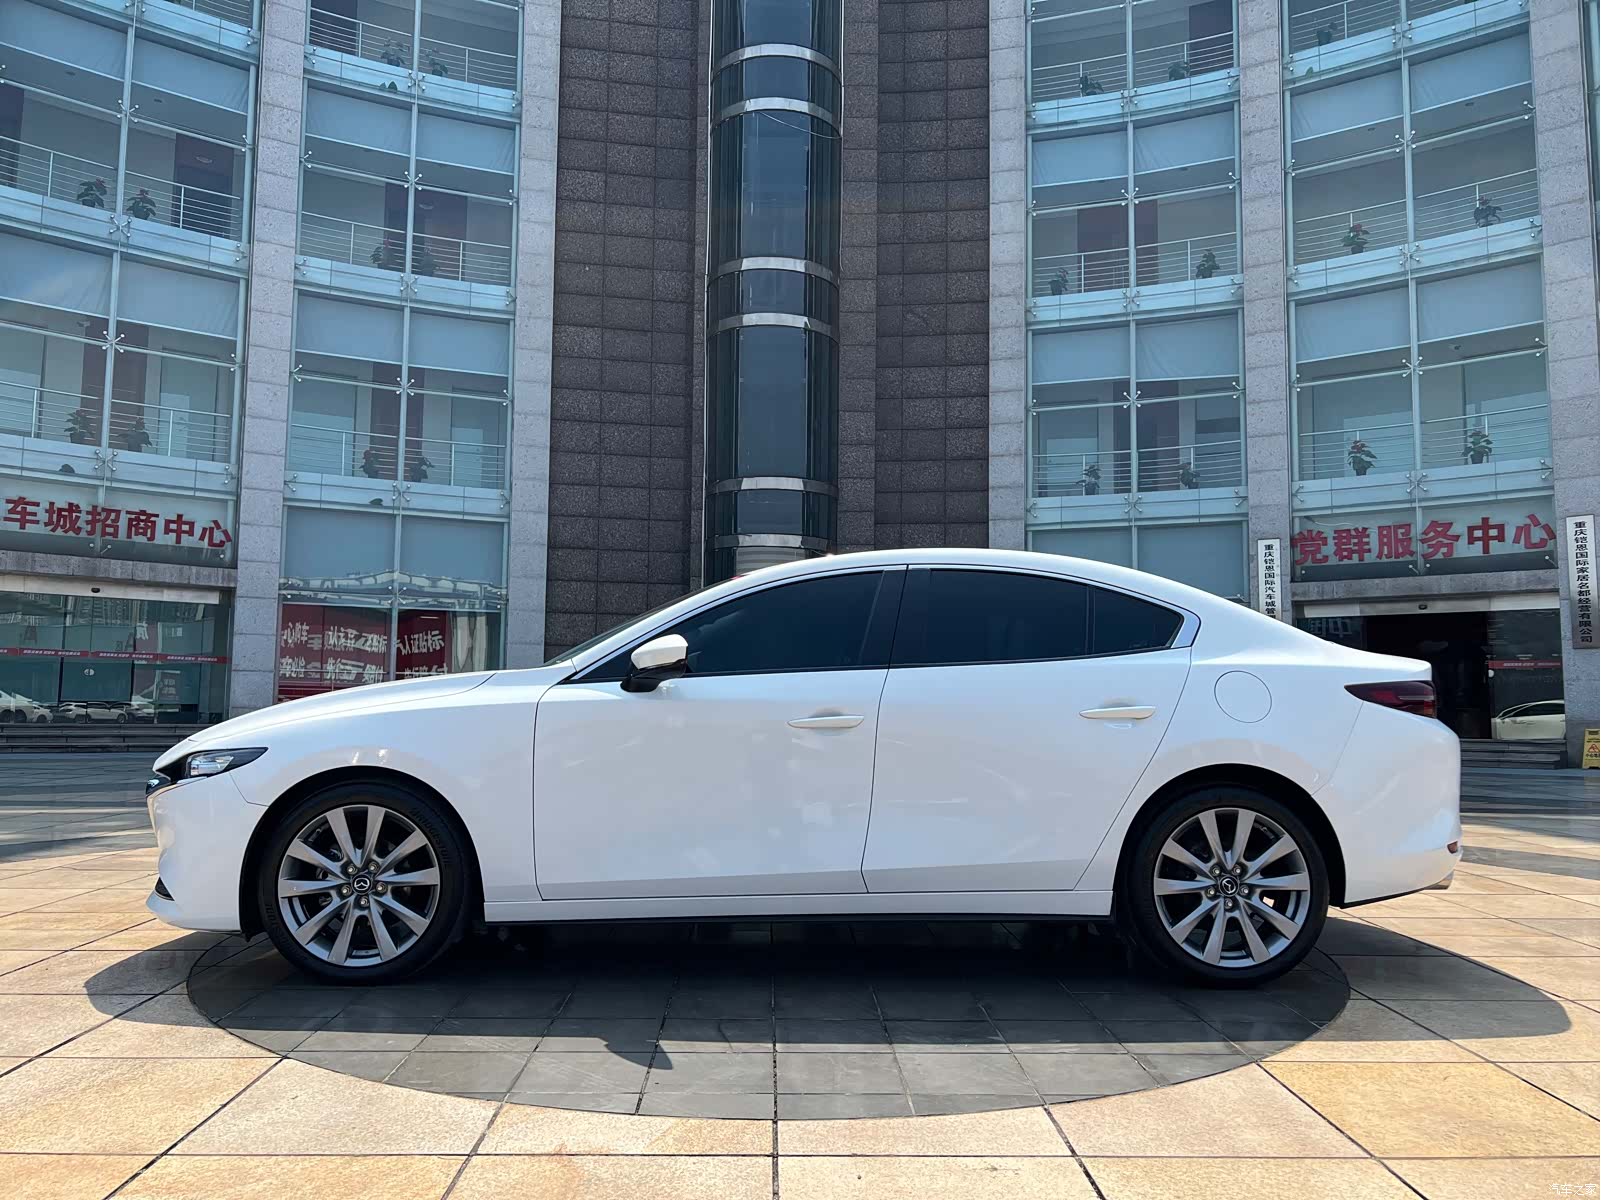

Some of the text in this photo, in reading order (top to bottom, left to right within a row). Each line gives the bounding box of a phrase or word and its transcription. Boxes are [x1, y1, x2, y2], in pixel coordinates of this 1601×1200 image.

[3, 496, 232, 549] 车城招商中心
[1291, 513, 1557, 566] 党群服务中心
[1573, 520, 1593, 643] 重庆铠恩国际家居名都经营有限公司
